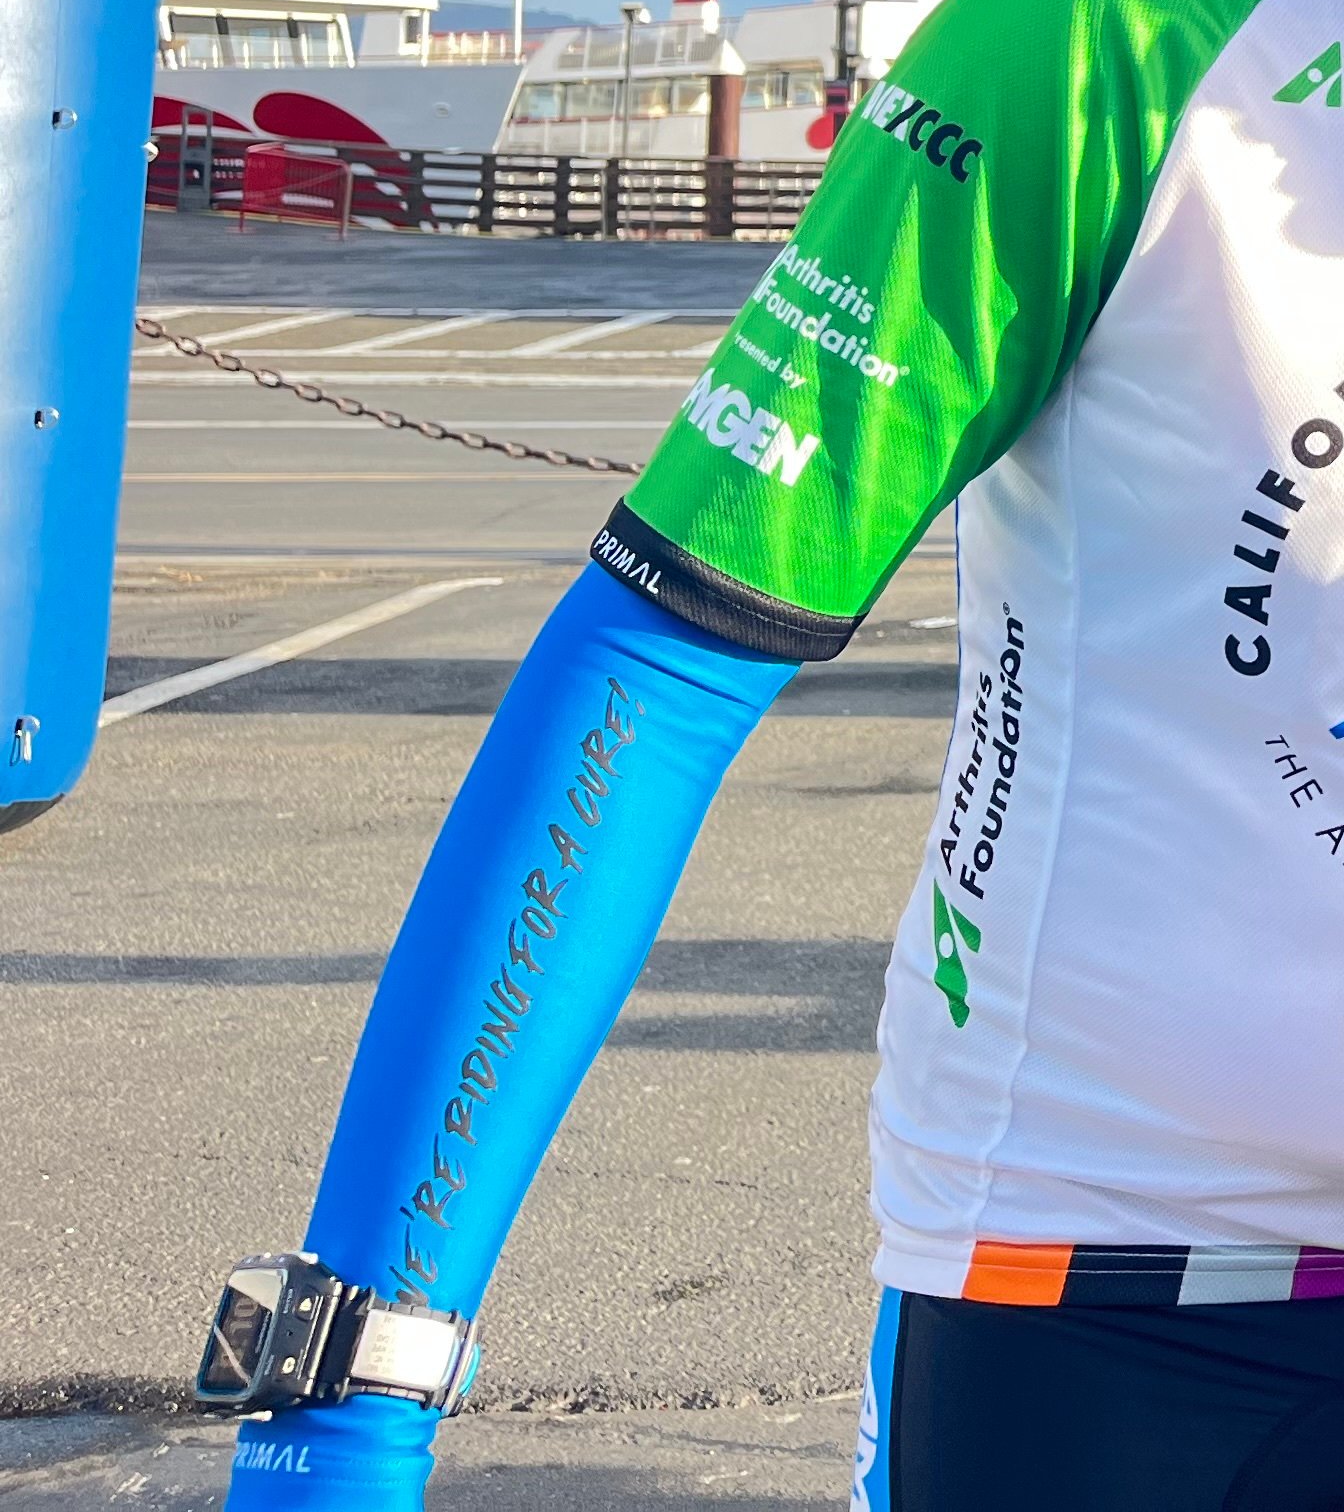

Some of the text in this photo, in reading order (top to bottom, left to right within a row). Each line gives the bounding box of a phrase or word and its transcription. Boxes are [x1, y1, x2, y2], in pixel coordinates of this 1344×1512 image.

[758, 276, 901, 388] Foundation
[779, 243, 876, 325] Arthritis
[780, 361, 807, 389] by
[593, 529, 662, 595] PRIMAL
[566, 676, 646, 828] CURE!
[940, 670, 993, 877] Arthritis
[959, 621, 1026, 901] Foundation
[1264, 733, 1324, 809] THE
[548, 823, 589, 875] A
[508, 868, 569, 976] FOR
[444, 962, 534, 1147] RIDING
